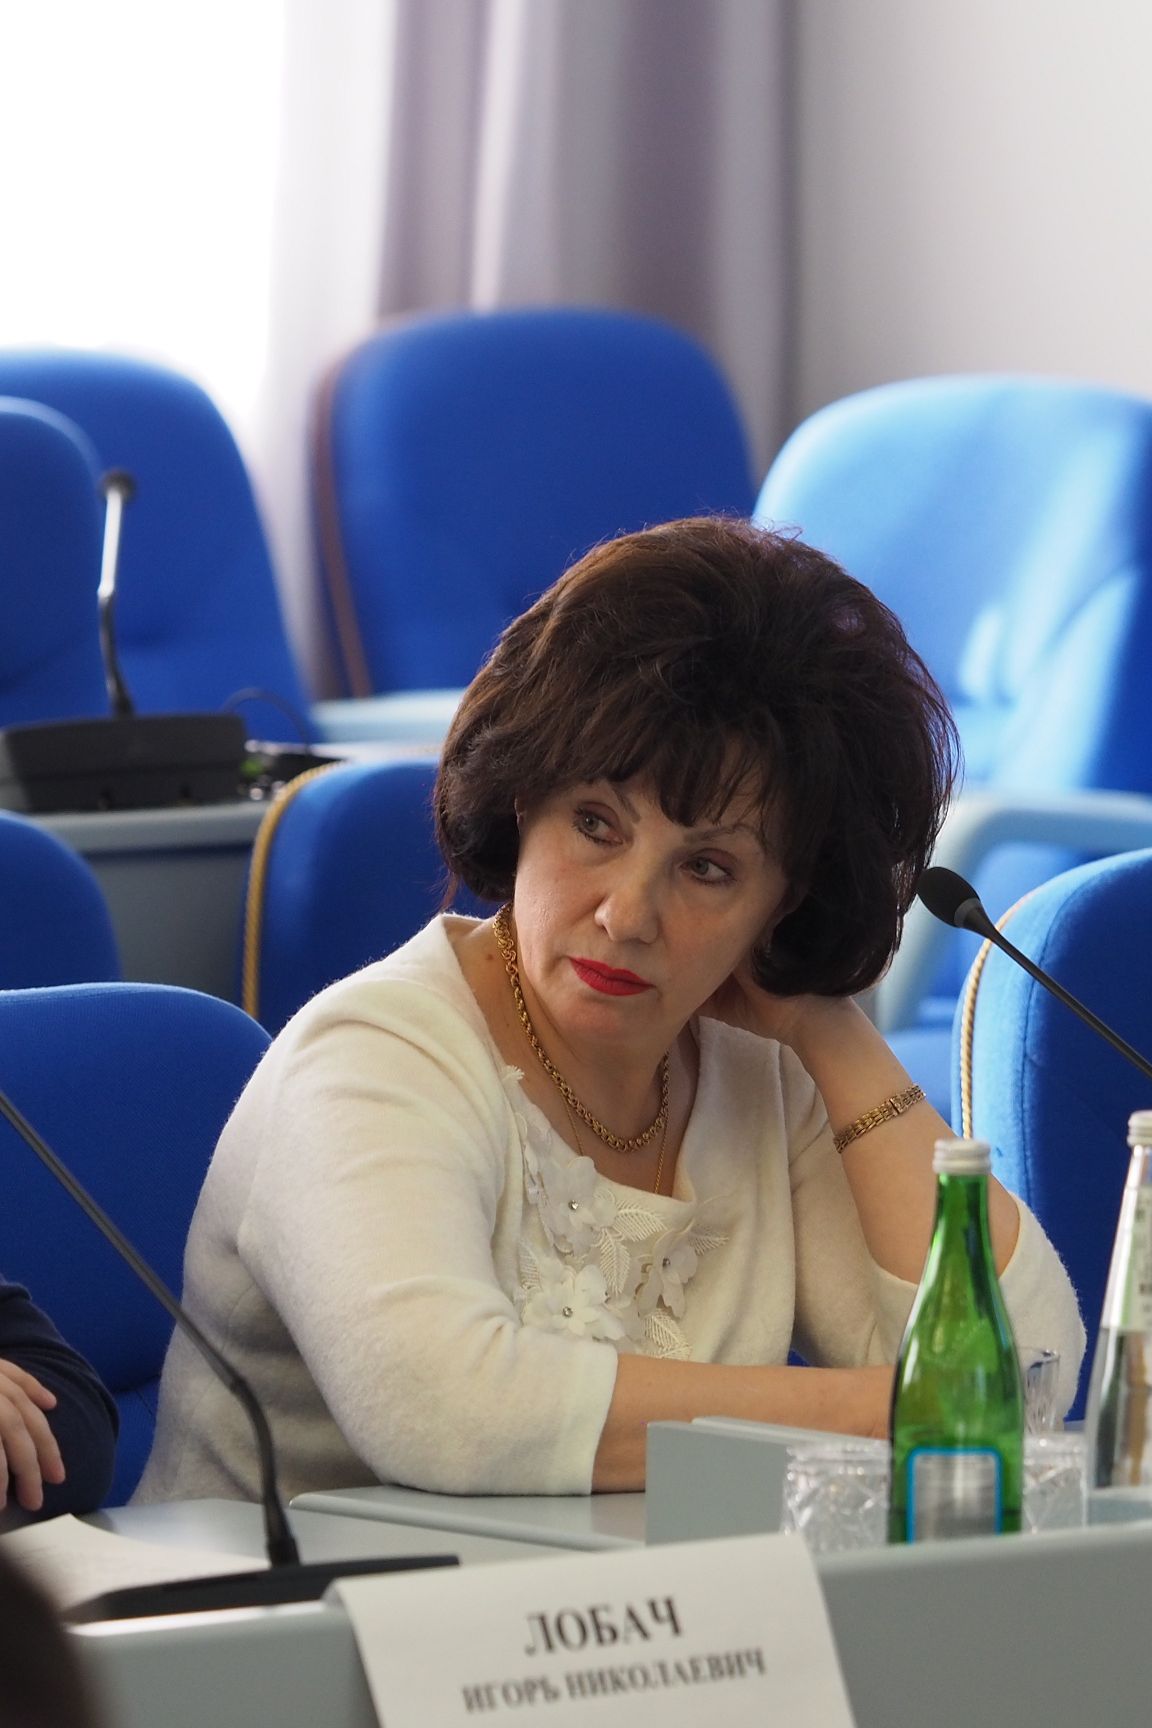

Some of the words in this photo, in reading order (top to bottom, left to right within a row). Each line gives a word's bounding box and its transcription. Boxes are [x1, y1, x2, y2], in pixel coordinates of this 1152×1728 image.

[525, 1595, 682, 1657] ЛОБАЧ
[462, 1677, 561, 1714] ИГОРЬ
[565, 1648, 767, 1699] НИКОЛАЕВИЧ
